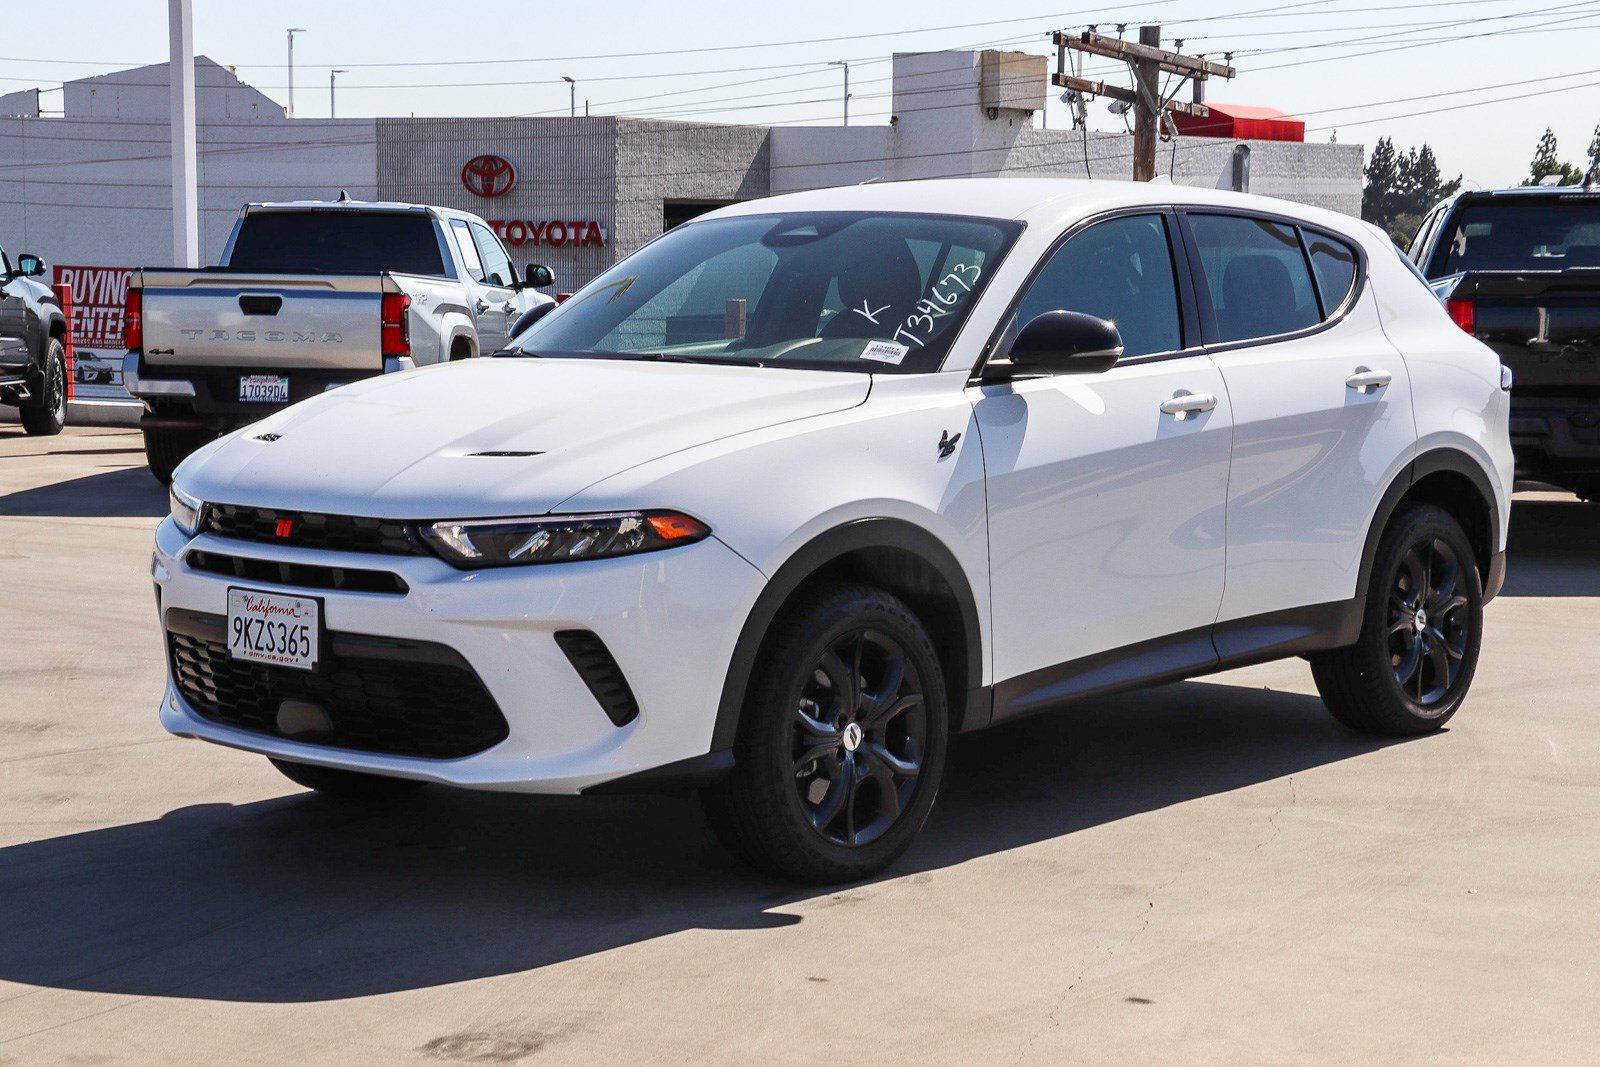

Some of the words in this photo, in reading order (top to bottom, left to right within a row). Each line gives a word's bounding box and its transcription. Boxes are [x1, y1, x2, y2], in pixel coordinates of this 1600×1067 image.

[487, 220, 606, 247] TOYOTA
[853, 299, 891, 325] K
[893, 263, 982, 347] T34673
[72, 306, 125, 340] ENTE
[180, 329, 344, 343] TACOMA
[242, 385, 286, 398] 17039D4
[246, 596, 300, 619] California
[232, 616, 310, 658] 9KZS365
[248, 651, 294, 663] dmv.ca.gov
